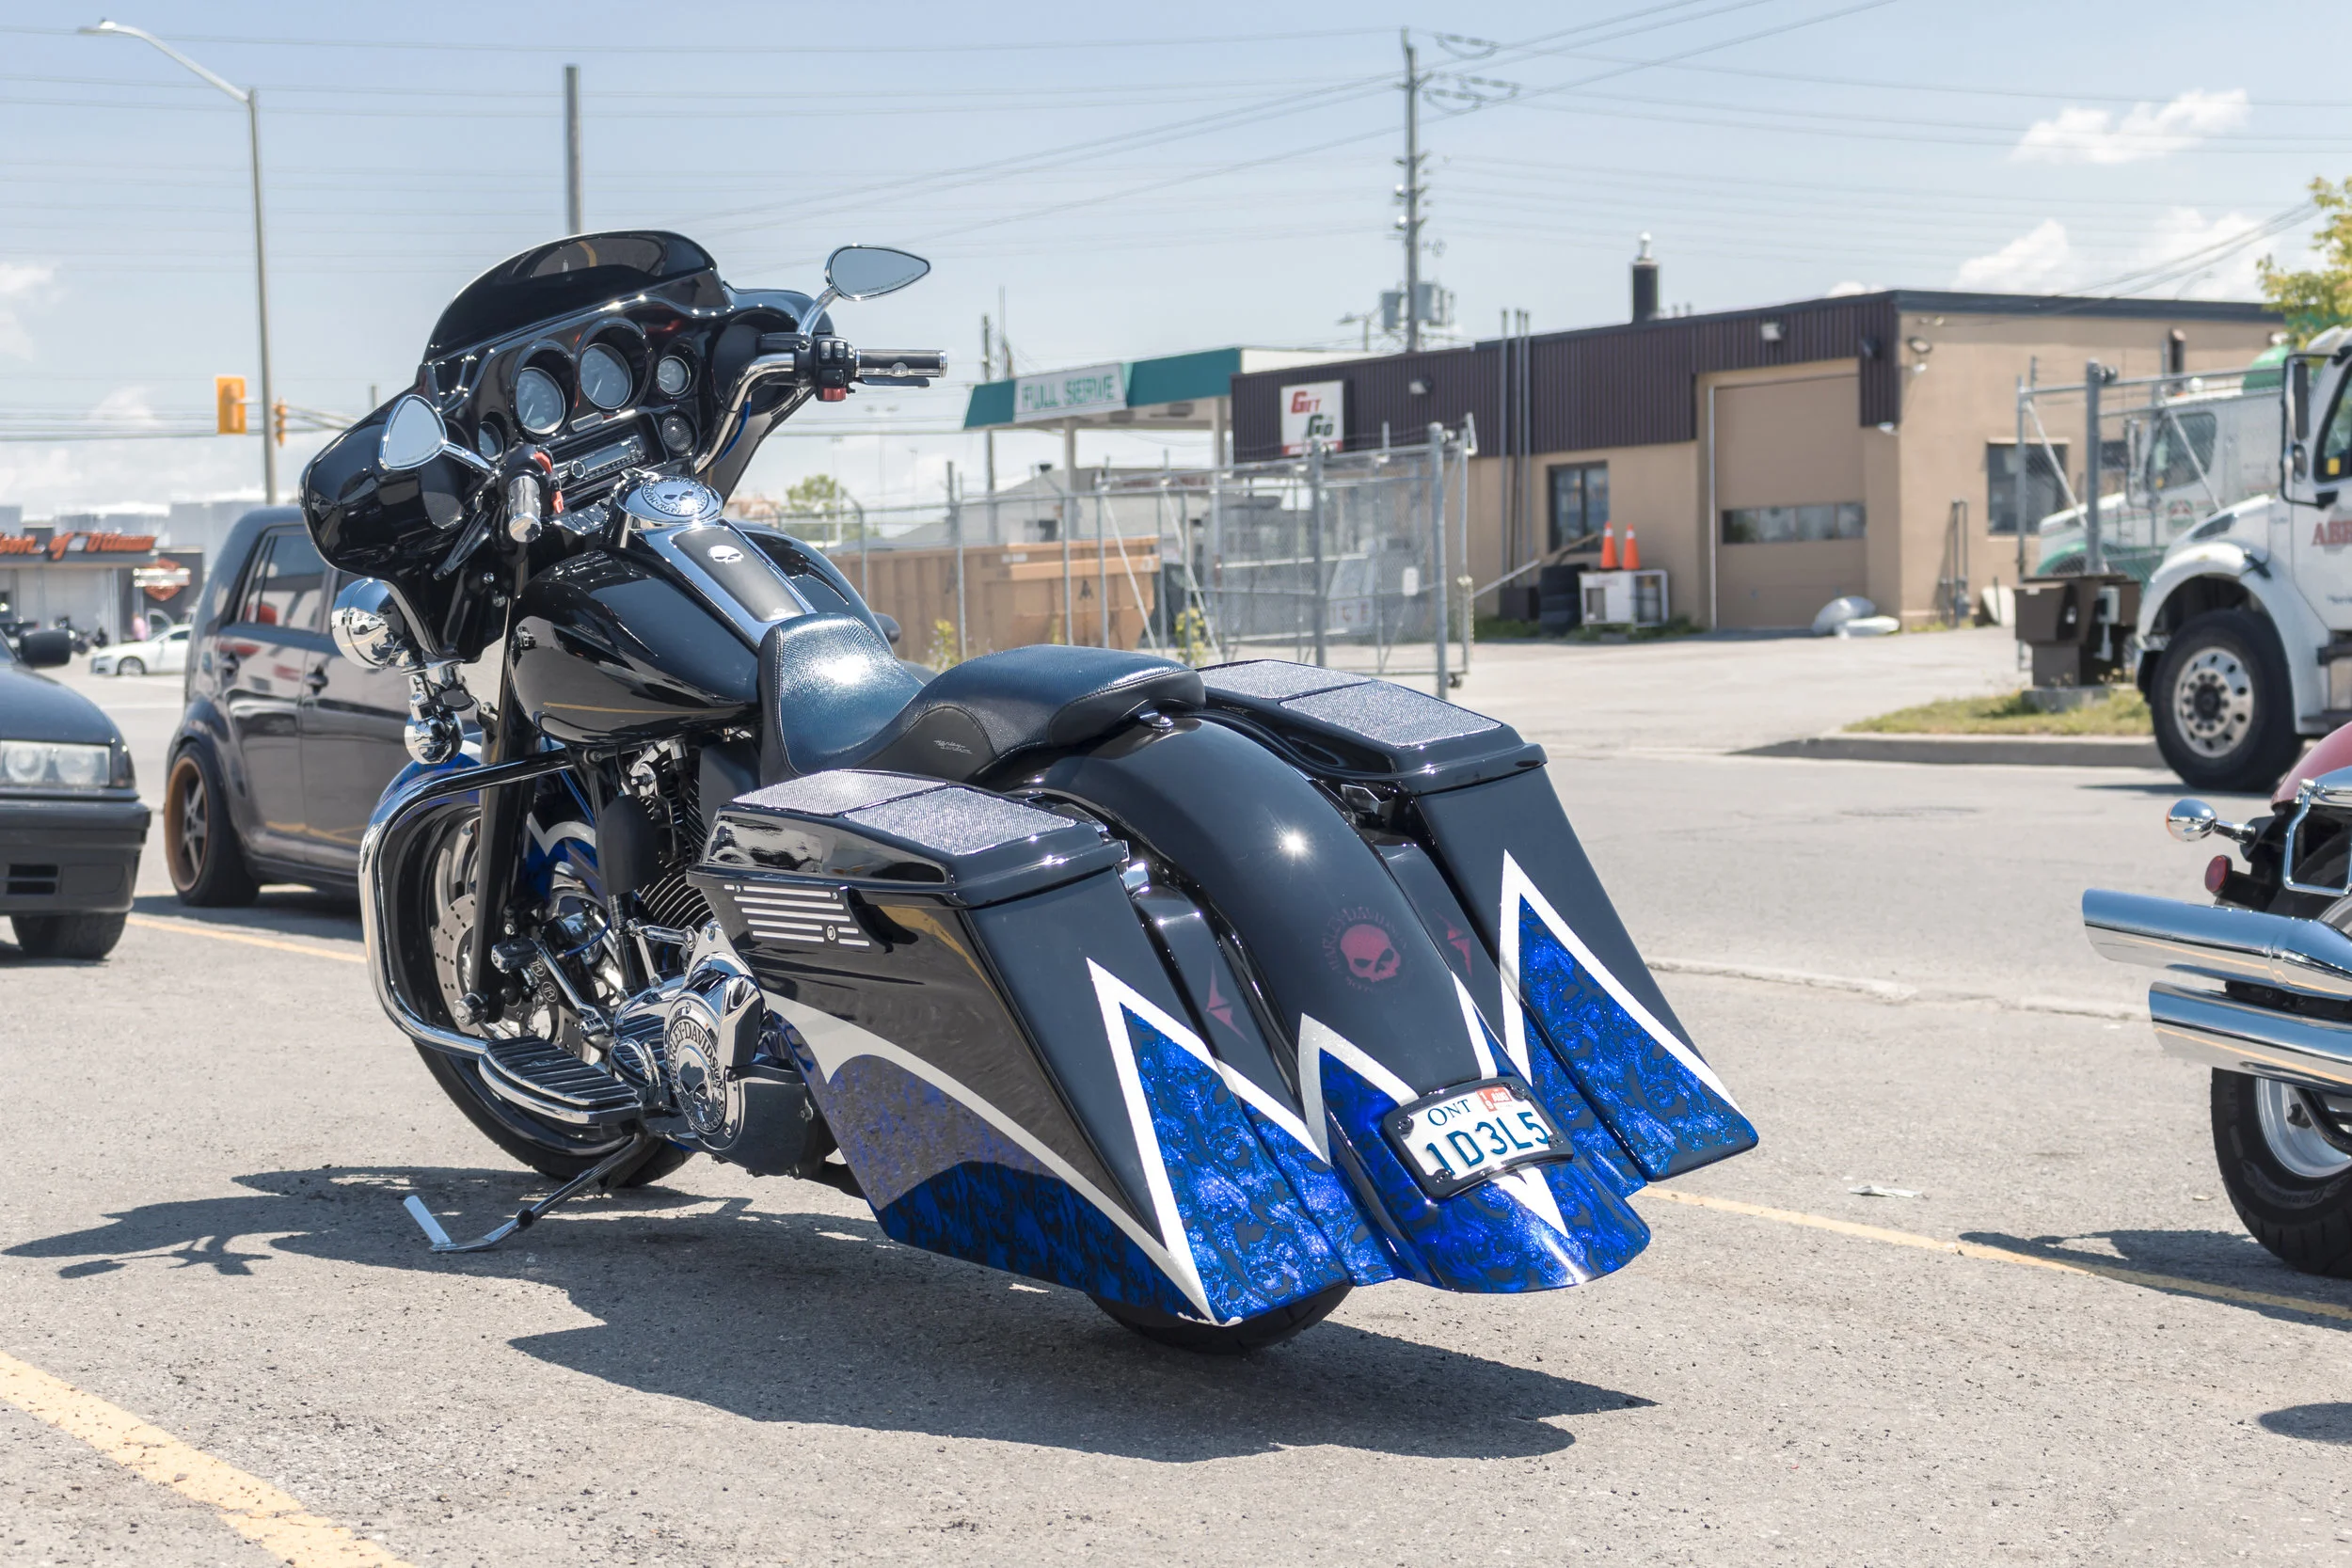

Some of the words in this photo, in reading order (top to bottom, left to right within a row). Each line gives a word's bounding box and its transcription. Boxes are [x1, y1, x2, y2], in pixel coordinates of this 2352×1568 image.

[1020, 384, 1059, 409] FULL
[1064, 375, 1115, 406] SERVE
[1425, 1111, 1549, 1176] 1D3L5
